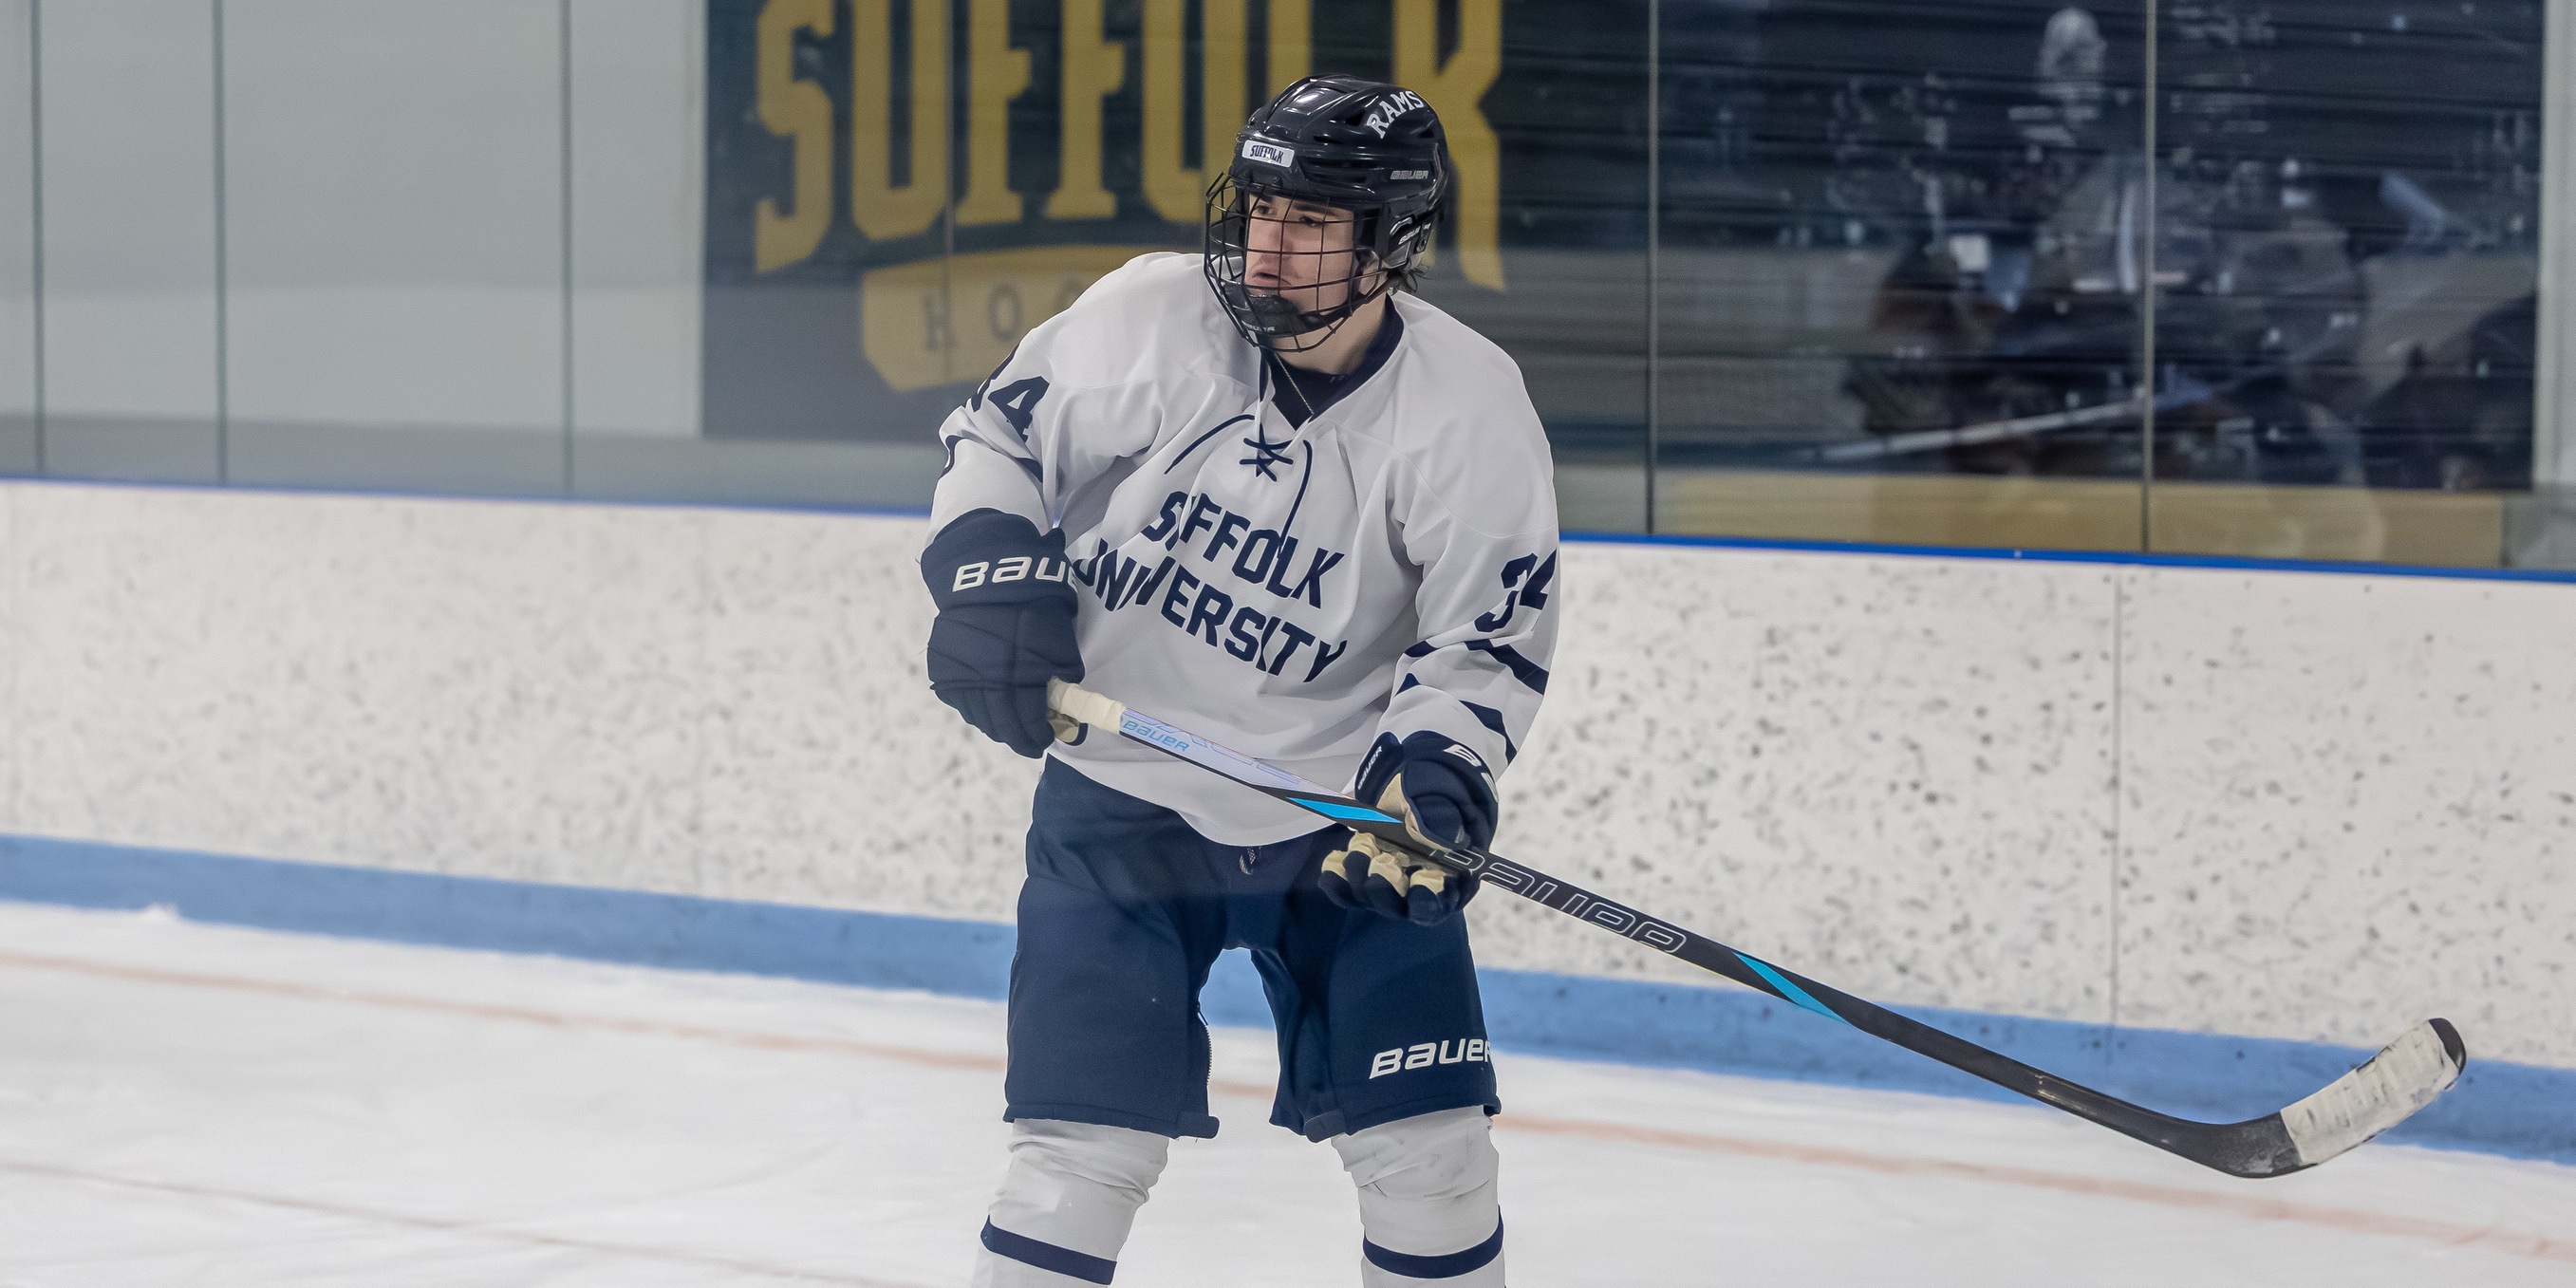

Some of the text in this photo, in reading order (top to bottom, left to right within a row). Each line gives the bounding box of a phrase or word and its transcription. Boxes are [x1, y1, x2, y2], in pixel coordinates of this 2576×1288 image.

[1367, 91, 1425, 139] RAMS
[970, 344, 1050, 443] 4
[1141, 491, 1345, 609] SFFOLK
[1123, 720, 1190, 752] BAUER
